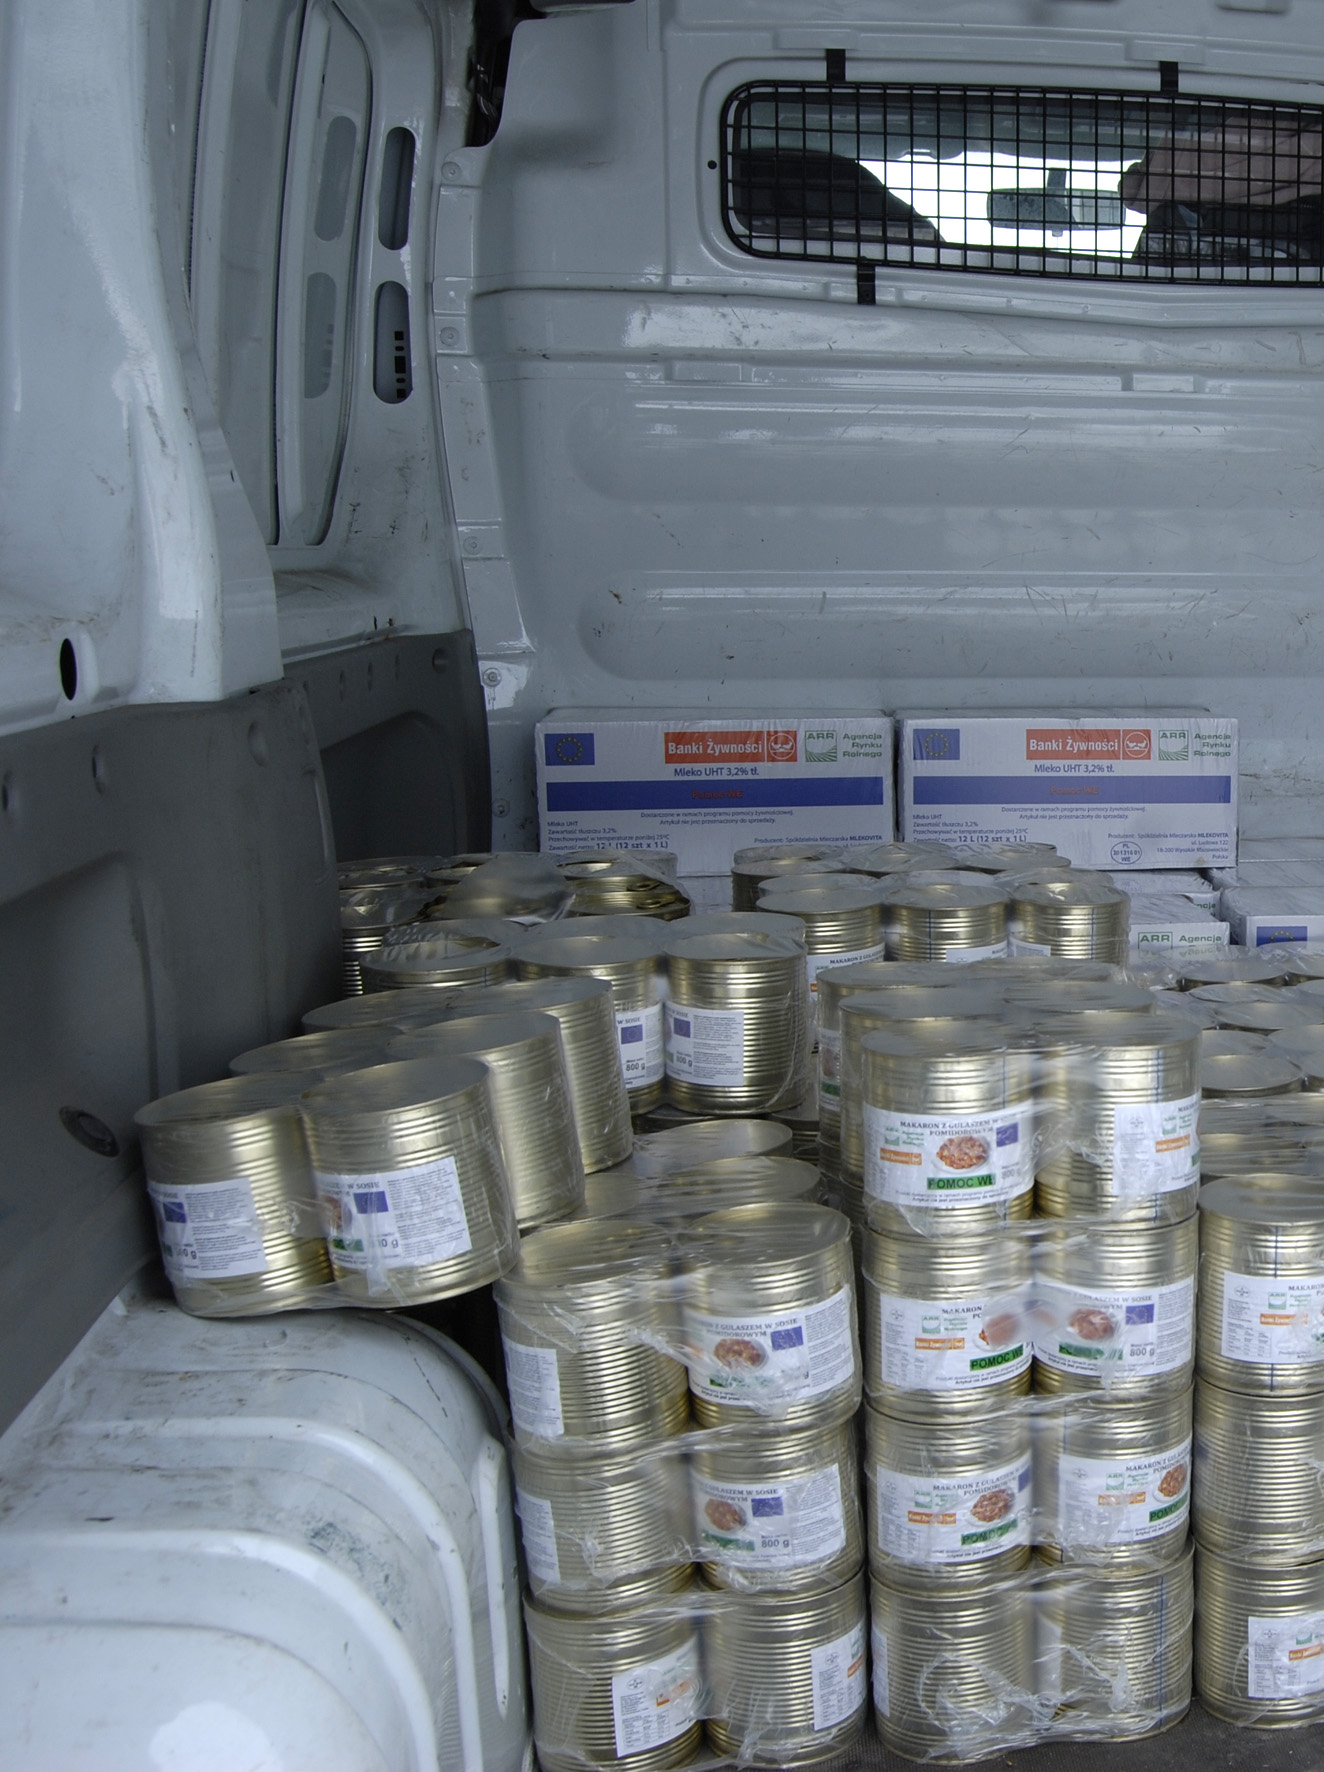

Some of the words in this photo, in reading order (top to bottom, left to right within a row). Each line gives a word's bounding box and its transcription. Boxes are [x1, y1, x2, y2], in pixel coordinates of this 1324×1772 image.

[806, 732, 835, 740] ARR
[842, 733, 882, 741] Agencja
[668, 741, 703, 754] Banki
[707, 739, 762, 755] Żywności
[1030, 739, 1063, 751] Banki
[1066, 736, 1118, 752] Żywności
[843, 750, 882, 758] Rolnego
[674, 768, 702, 777] Mleko
[704, 768, 724, 776] UHT
[726, 767, 749, 777] 3,2%
[751, 767, 759, 775] tł.
[1034, 764, 1061, 773] Mleko
[1063, 764, 1082, 772] UHT
[1083, 764, 1105, 773] 3,2%
[1106, 764, 1115, 772] tł.
[727, 790, 743, 798] WE
[1084, 786, 1099, 795] WE
[976, 835, 989, 843] (12
[616, 842, 628, 850] (12
[660, 841, 668, 849] L)
[1140, 934, 1170, 943] ARR
[1179, 934, 1222, 943] Agencja
[626, 1063, 639, 1071] 800
[900, 1121, 939, 1129] MAKARON
[1131, 1295, 1153, 1303] SOSIE
[942, 1306, 982, 1315] MAKARON
[1130, 1347, 1147, 1357] 800
[1149, 1347, 1155, 1357] g
[971, 1355, 1010, 1369] POMOC
[1125, 1461, 1161, 1472] MAKARON
[933, 1482, 974, 1491] MAKARON
[761, 1539, 779, 1548] 800
[782, 1540, 790, 1549] g
